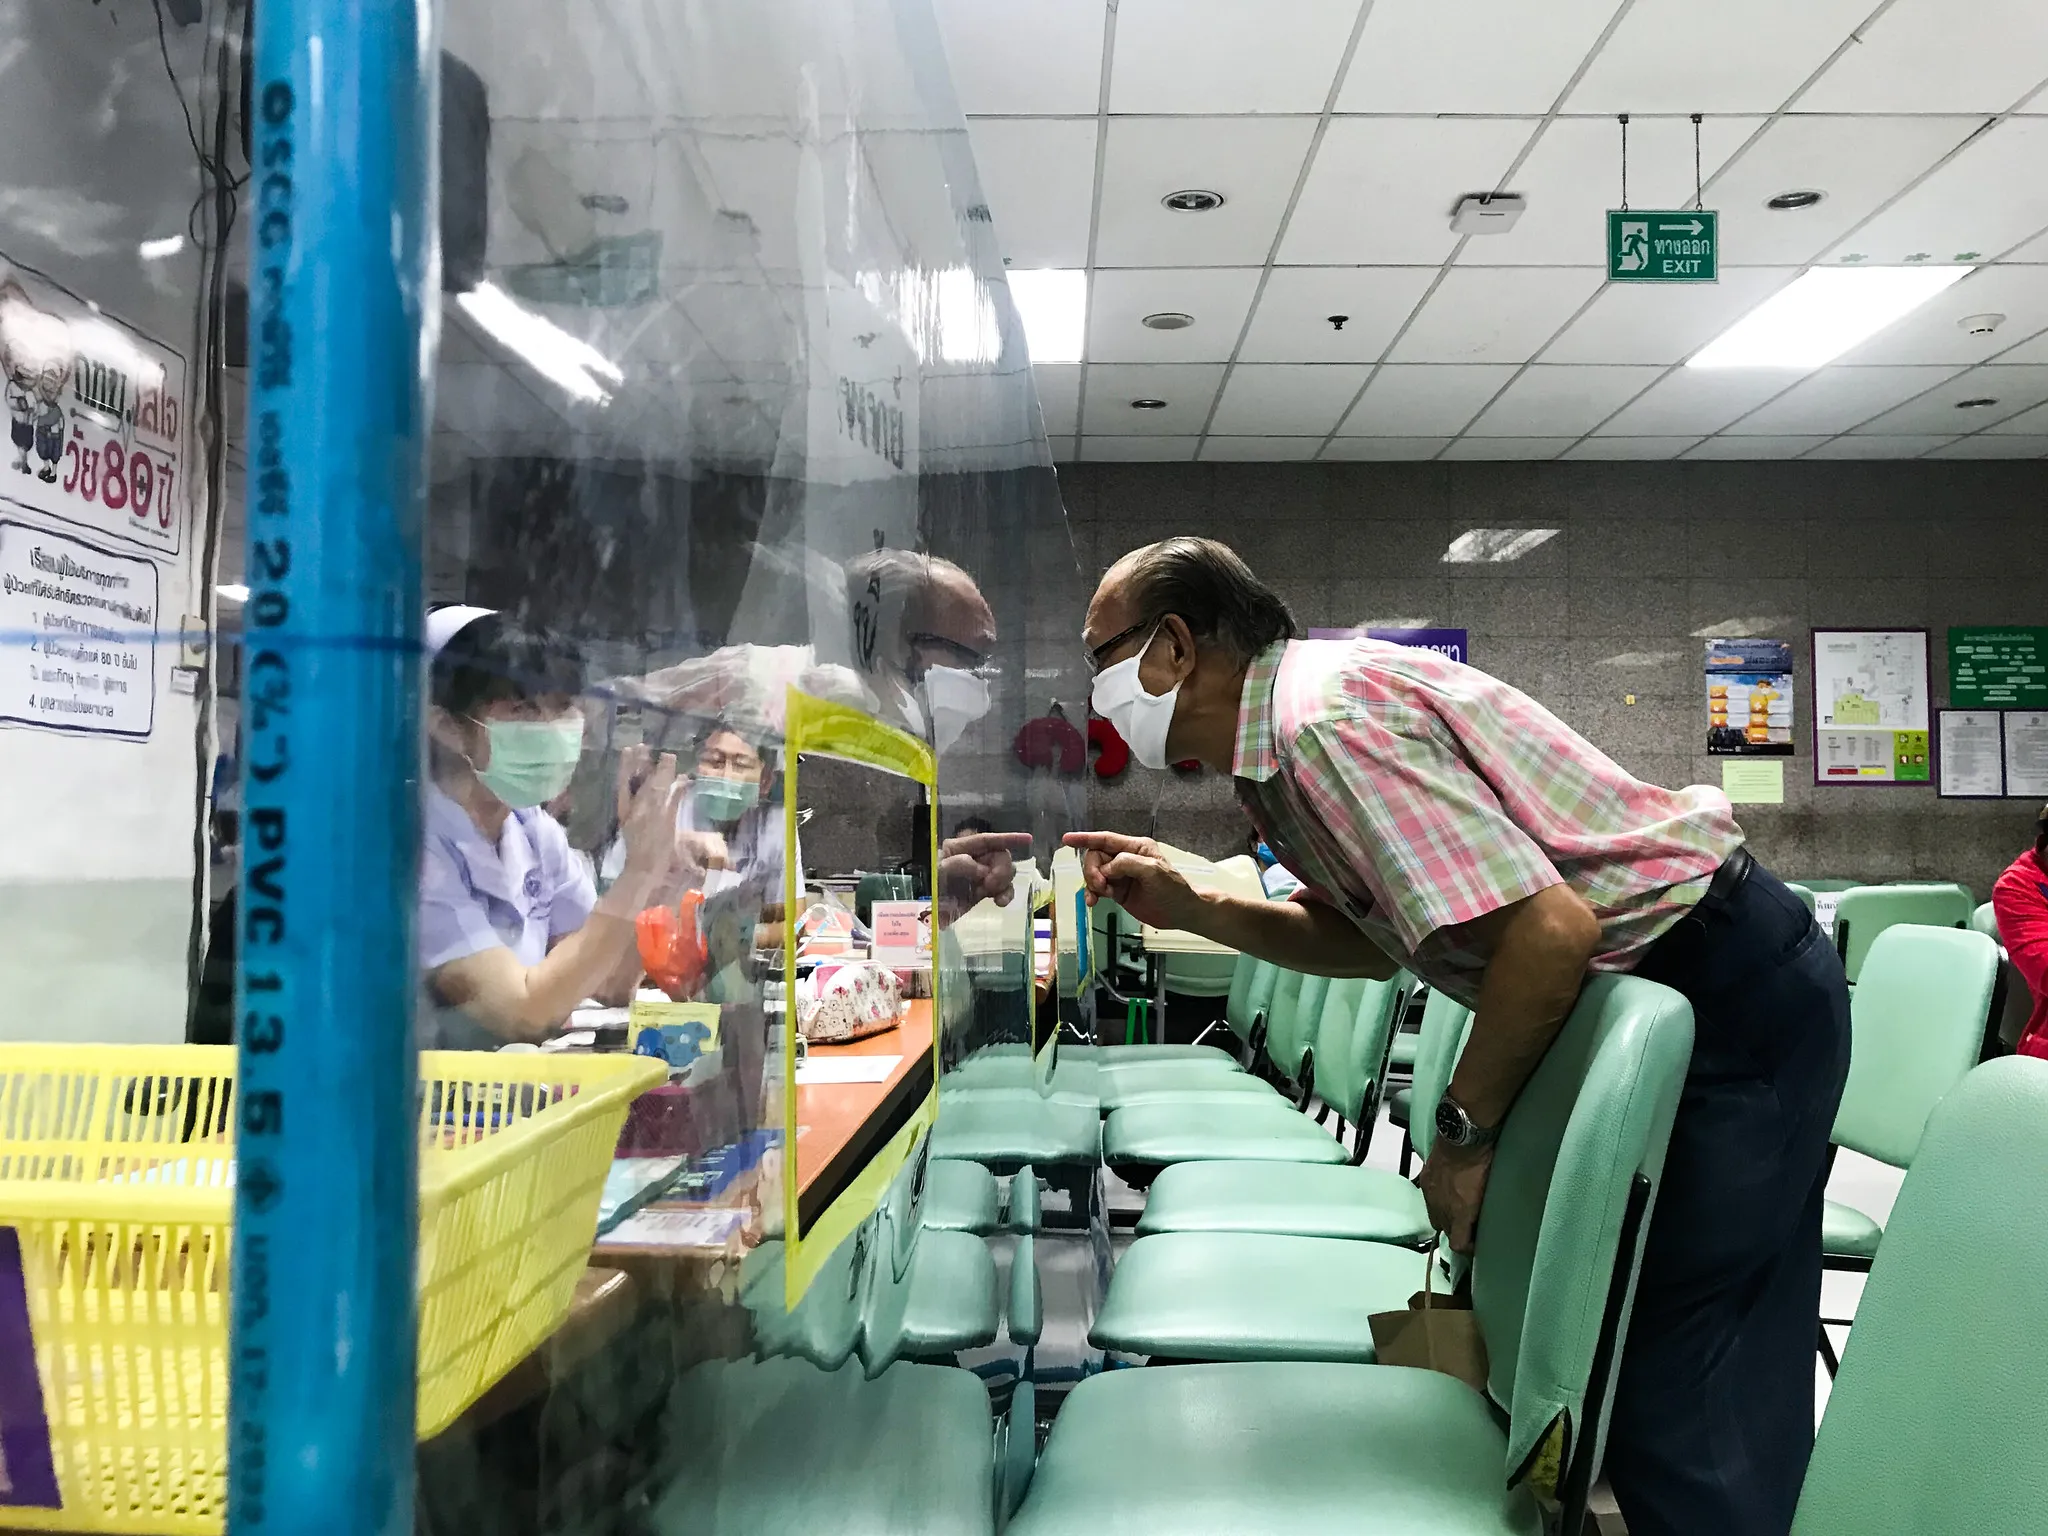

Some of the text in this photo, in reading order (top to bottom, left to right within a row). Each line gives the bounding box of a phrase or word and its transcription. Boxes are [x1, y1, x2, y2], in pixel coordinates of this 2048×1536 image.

[1654, 239, 1710, 255] ทางออก
[1662, 260, 1701, 273] EXIT
[250, 538, 290, 627] 20
[101, 652, 111, 665] 80
[246, 806, 287, 945] PVC
[243, 971, 285, 1137] 13.5
